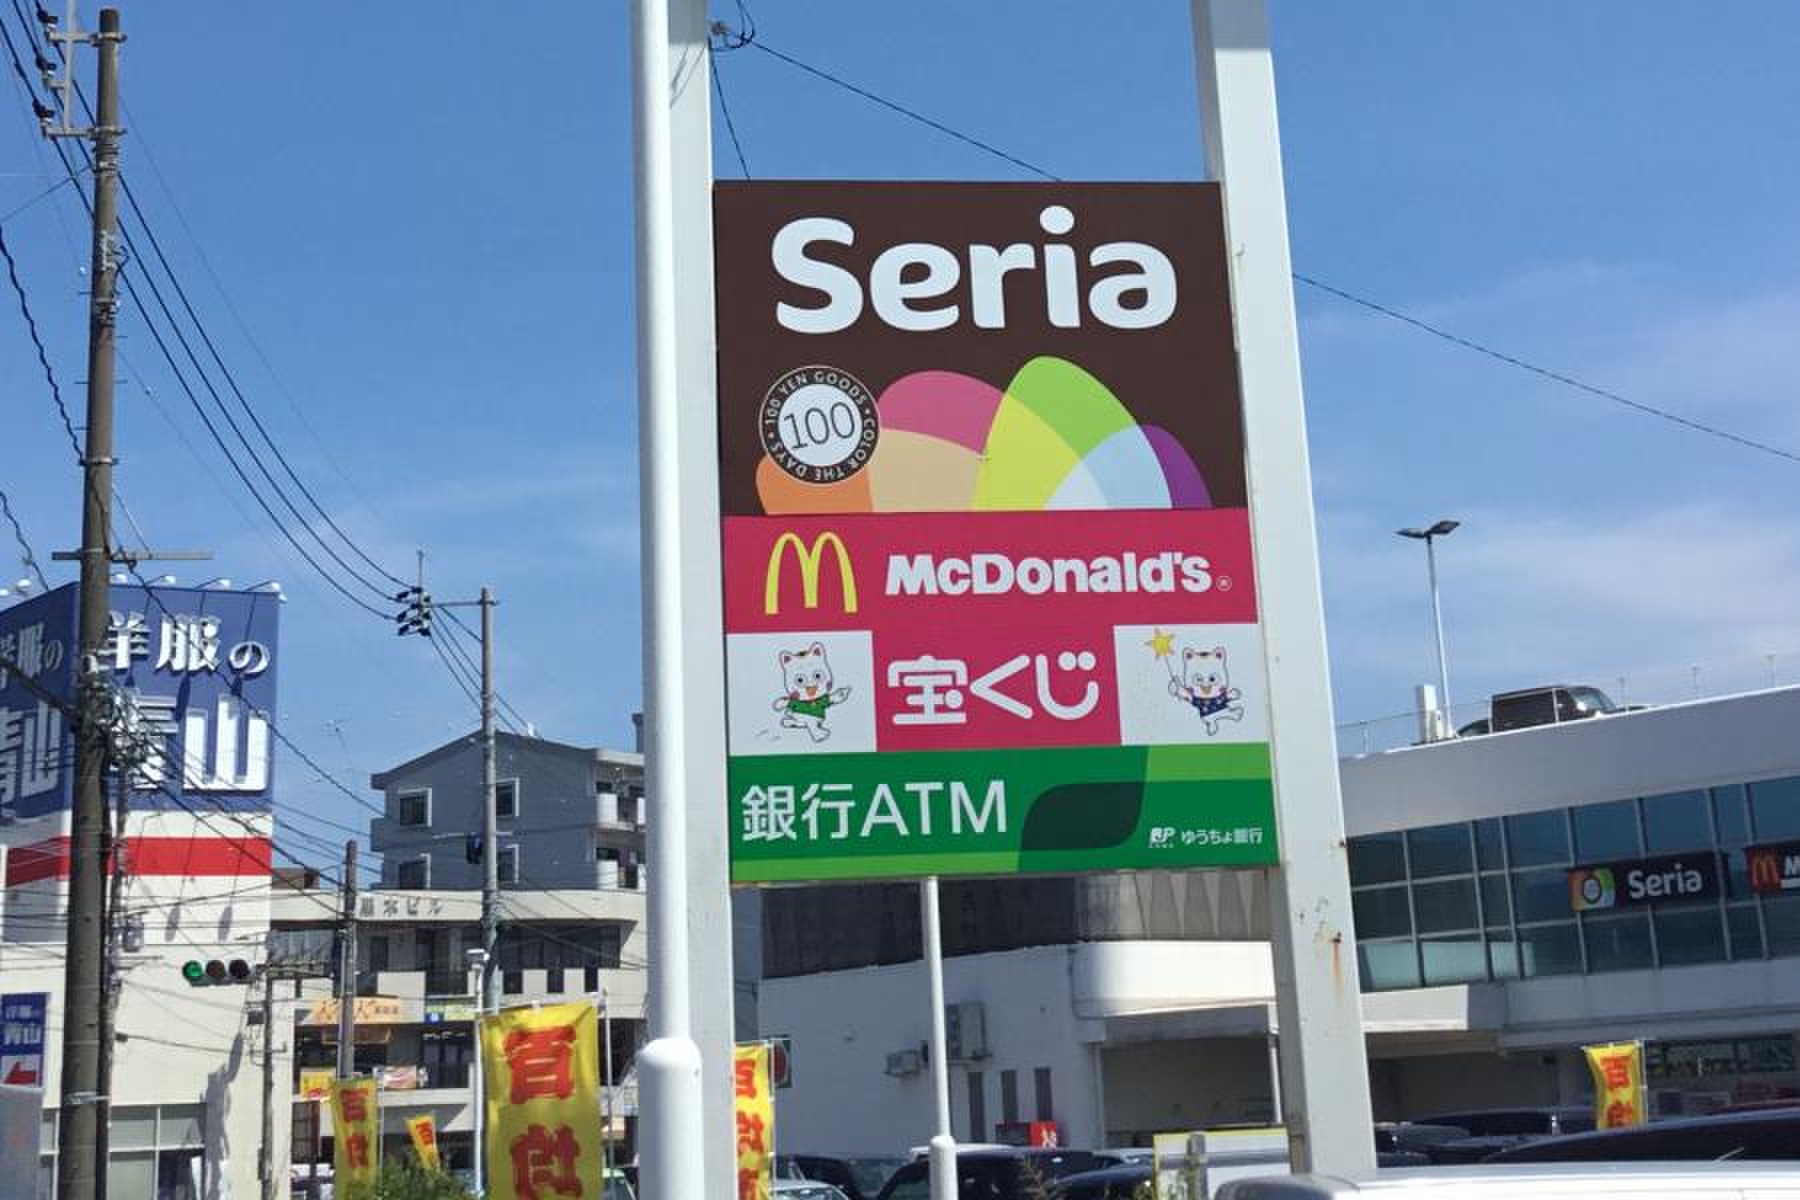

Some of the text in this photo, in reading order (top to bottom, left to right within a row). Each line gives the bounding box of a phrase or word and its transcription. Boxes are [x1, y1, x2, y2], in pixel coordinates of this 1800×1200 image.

[770, 204, 1178, 334] Seria
[779, 371, 808, 395] YEN
[814, 370, 868, 405] GOODS
[783, 401, 855, 449] 100
[886, 551, 1211, 596] McDonald's
[886, 653, 1098, 726] 宝くじ
[741, 780, 1008, 843] 銀行ATM
[1628, 863, 1703, 899] Seria
